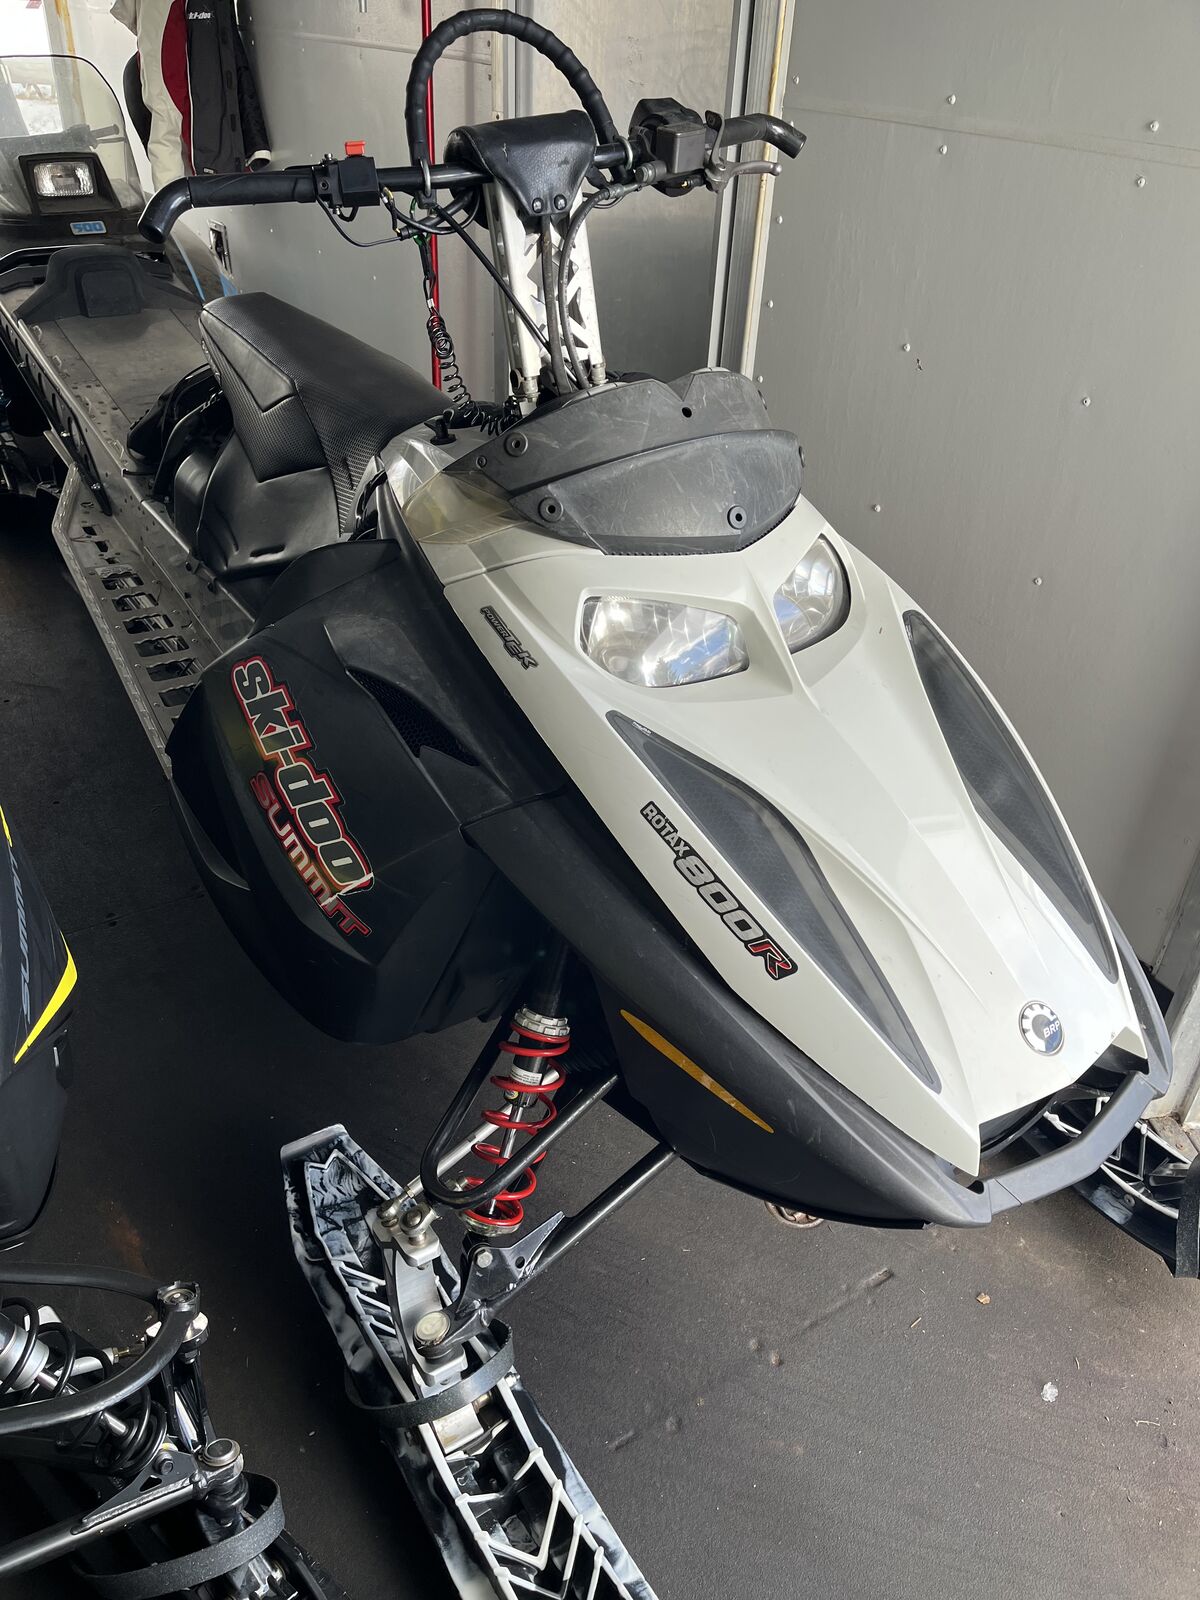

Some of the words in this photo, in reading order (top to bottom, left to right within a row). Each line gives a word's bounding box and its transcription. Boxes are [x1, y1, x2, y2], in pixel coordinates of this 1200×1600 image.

[231, 656, 373, 890] ski-doo
[641, 801, 690, 857] ROTAX
[674, 854, 797, 979] 800R
[1043, 1020, 1061, 1039] BRP
